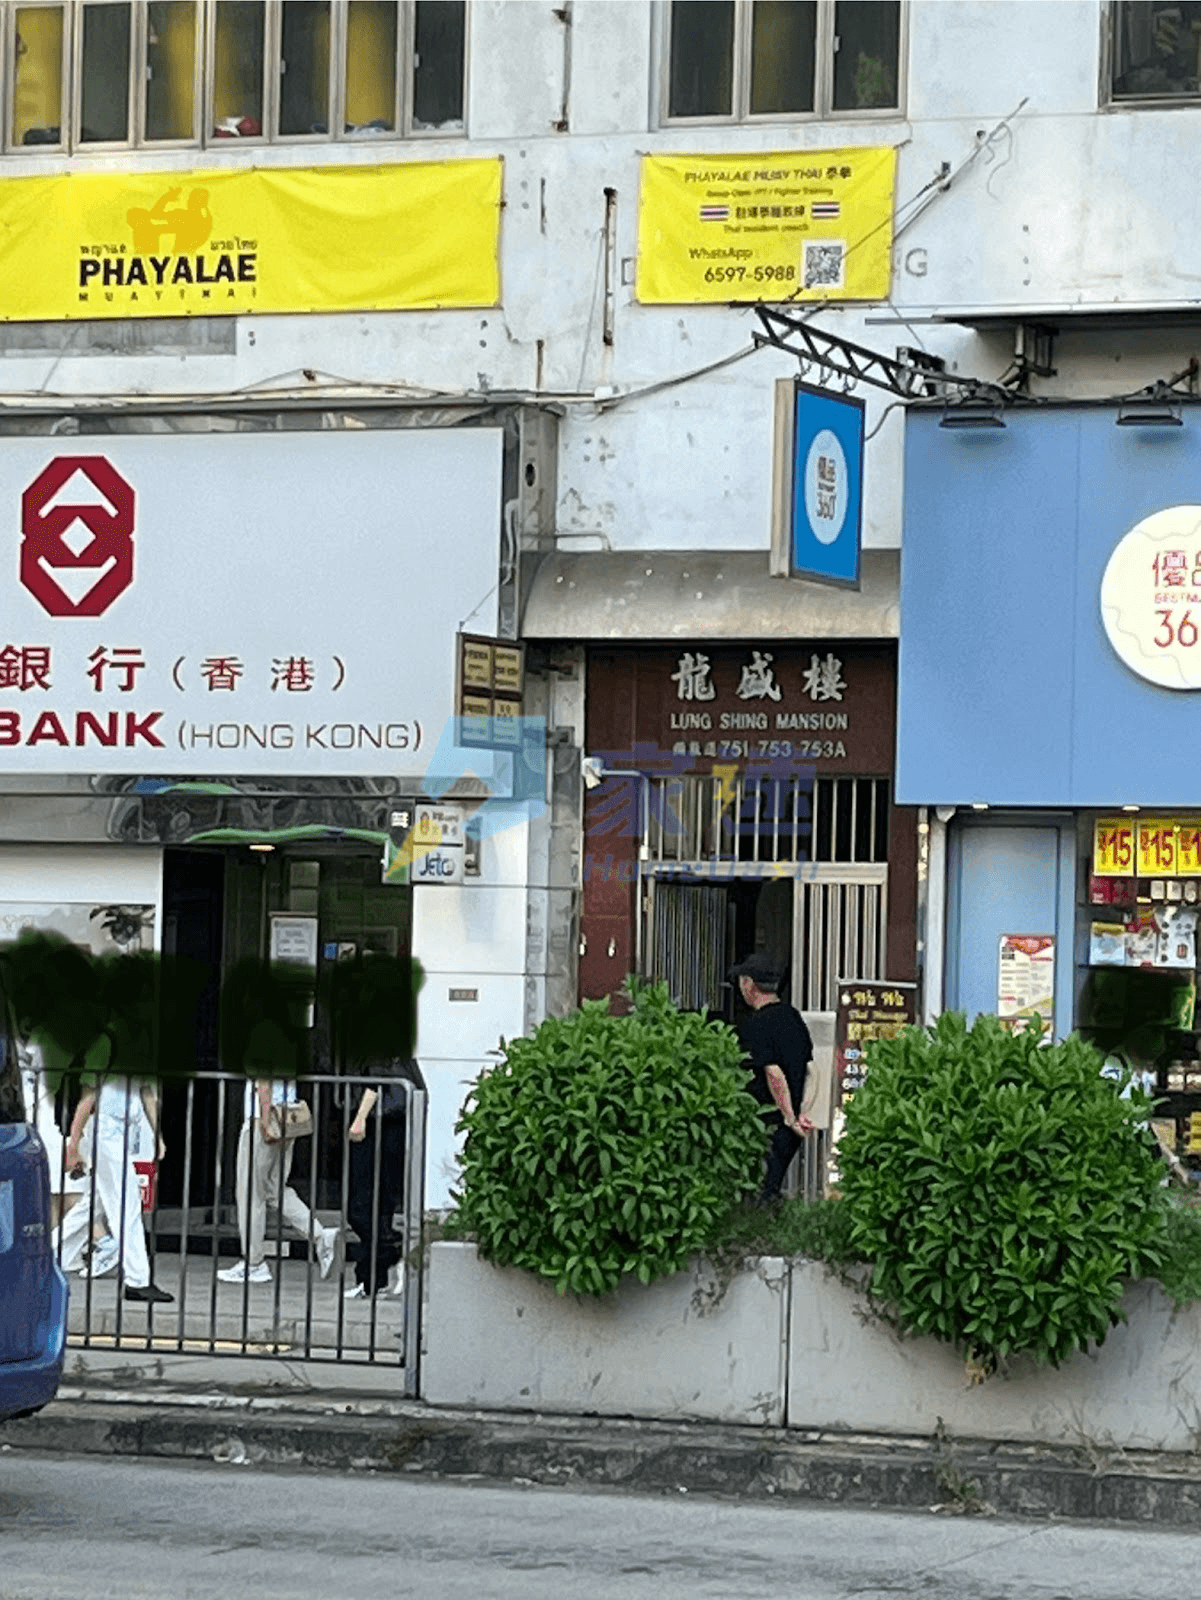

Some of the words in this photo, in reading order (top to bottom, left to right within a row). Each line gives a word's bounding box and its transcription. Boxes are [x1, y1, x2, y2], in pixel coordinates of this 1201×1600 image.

[685, 170, 752, 183] PHAYALAE
[754, 167, 790, 181] MUAY
[793, 167, 823, 180] THAI
[688, 247, 753, 261] WhatsApp
[79, 253, 257, 287] PHAYALAE
[704, 265, 795, 282] 6597-5988
[1152, 550, 1201, 587] 優
[671, 650, 848, 701] 龍盛樓
[670, 713, 712, 730] LUNG
[719, 713, 769, 730] SHING
[775, 713, 848, 730] MANSION
[178, 719, 294, 750] (HONG
[306, 719, 422, 750] KONG)
[758, 740, 793, 757] 753
[800, 740, 847, 758] 753A
